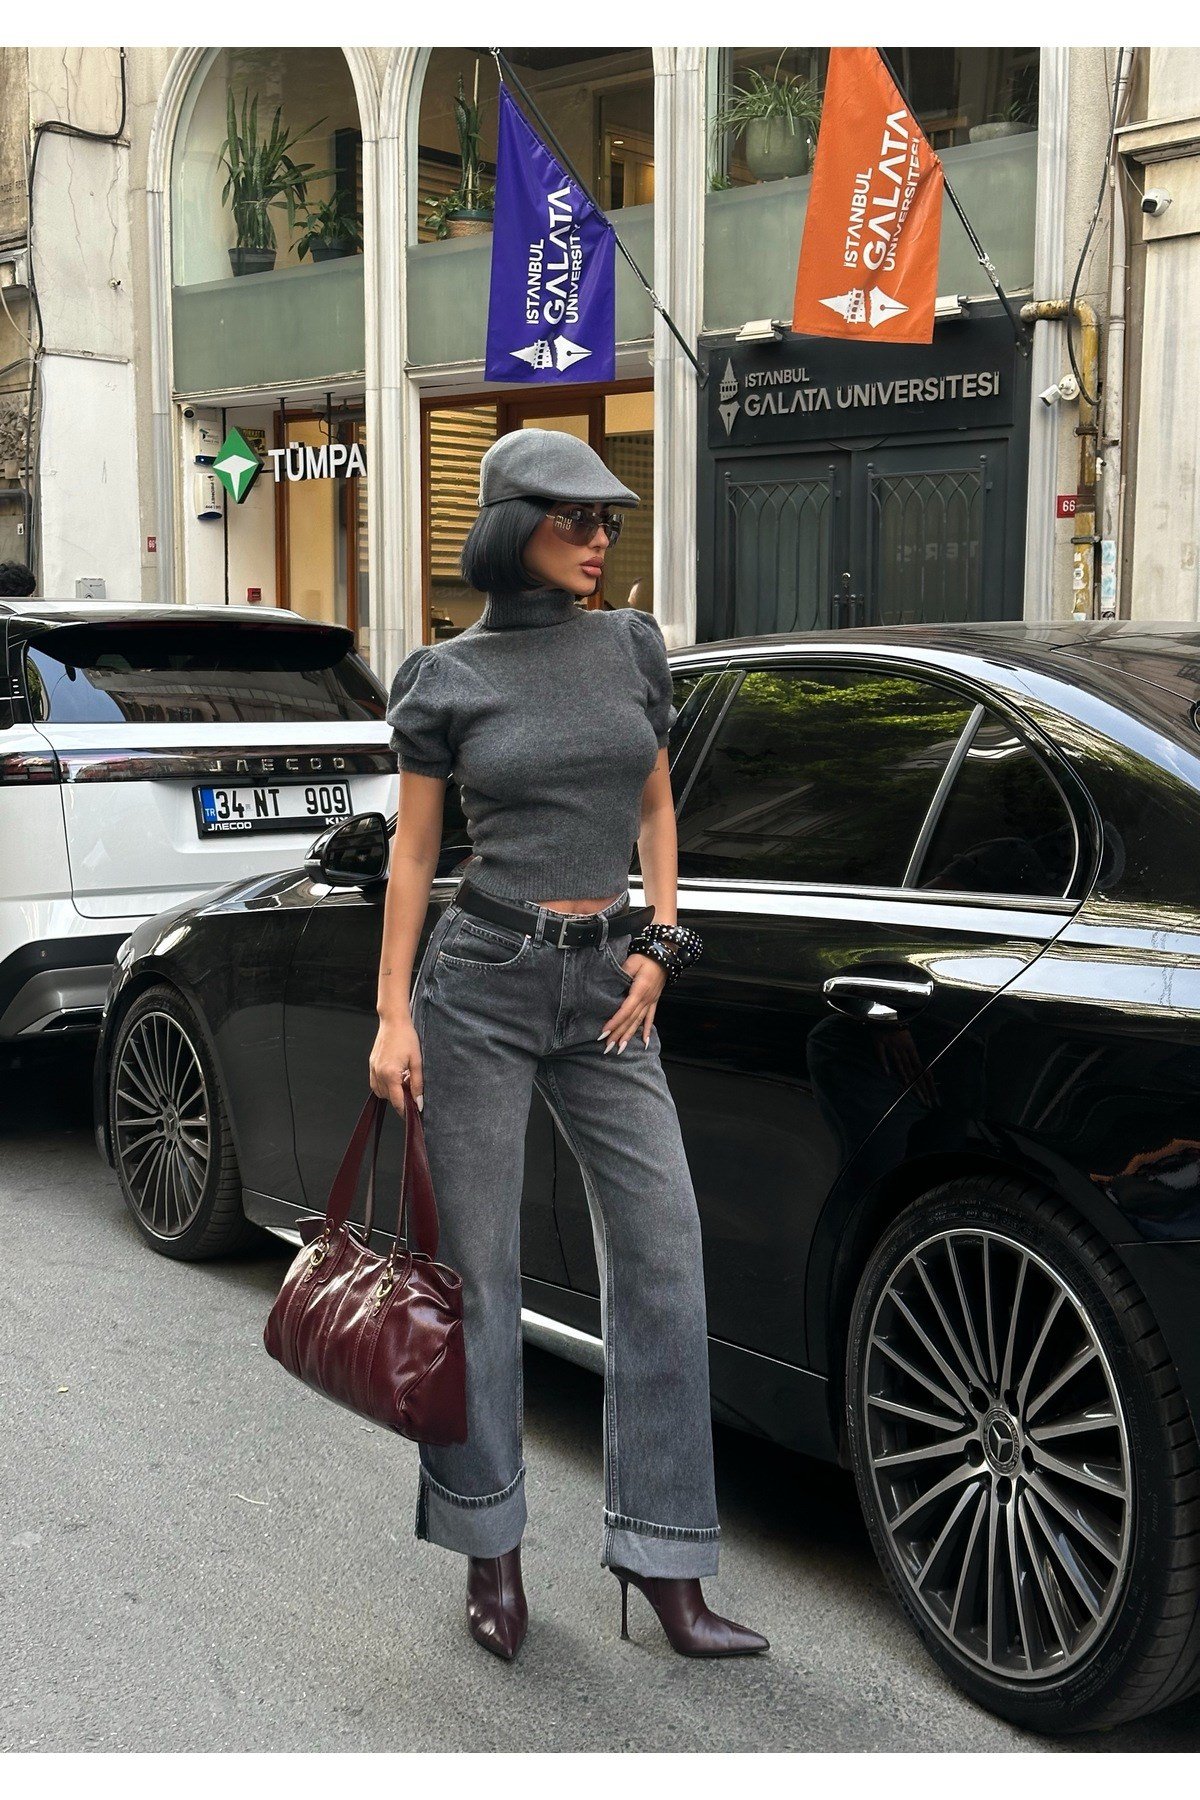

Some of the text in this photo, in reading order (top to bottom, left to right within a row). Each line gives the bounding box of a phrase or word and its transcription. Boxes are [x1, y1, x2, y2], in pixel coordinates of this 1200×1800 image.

[862, 109, 909, 271] GALATA
[543, 186, 573, 325] GALATA
[565, 224, 583, 324] UNIVERSITY
[744, 387, 832, 417] GALATA
[267, 441, 367, 483] TÜMPA
[1062, 500, 1076, 512] 66
[209, 757, 345, 772] JAECOO
[205, 808, 216, 817] TR
[215, 786, 347, 819] 34 NT 909
[207, 821, 252, 831] JAECOO
